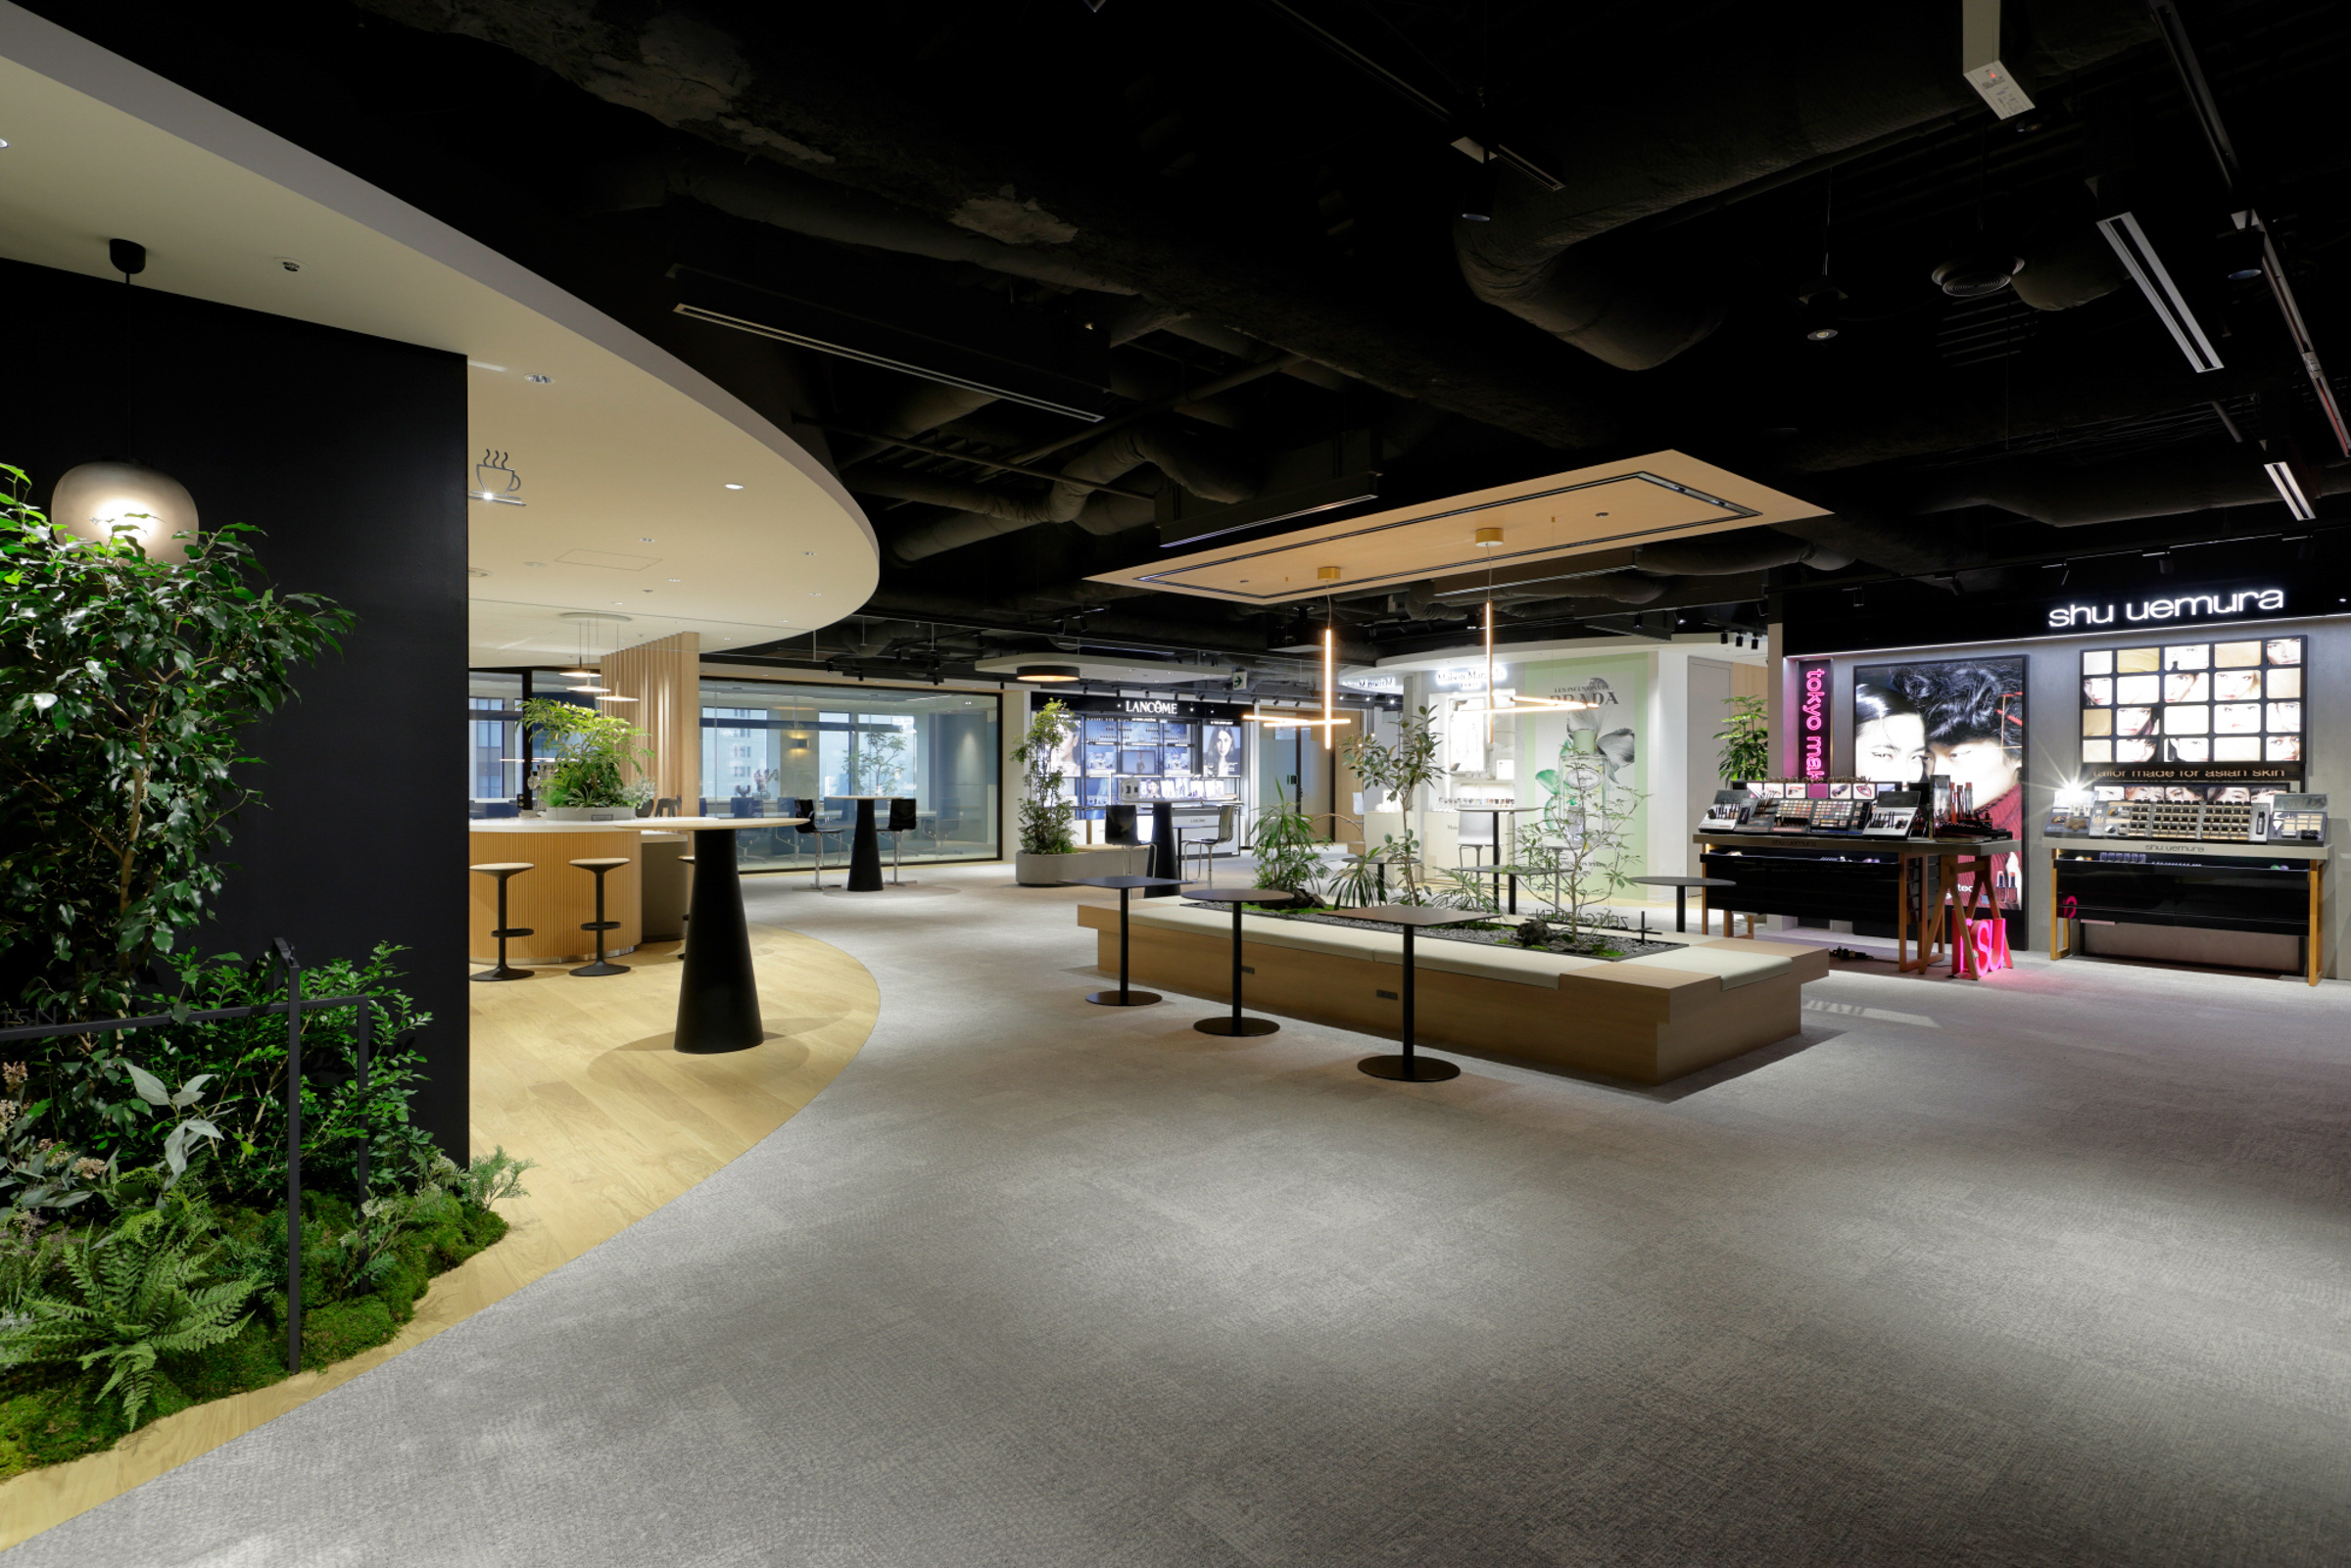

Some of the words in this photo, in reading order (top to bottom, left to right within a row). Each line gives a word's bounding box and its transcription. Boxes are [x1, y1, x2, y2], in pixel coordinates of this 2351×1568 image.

[2048, 603, 2115, 628] shu
[2125, 589, 2284, 621] uemura
[1126, 699, 1177, 715] LANCÔME
[1802, 668, 1825, 731] tokyo
